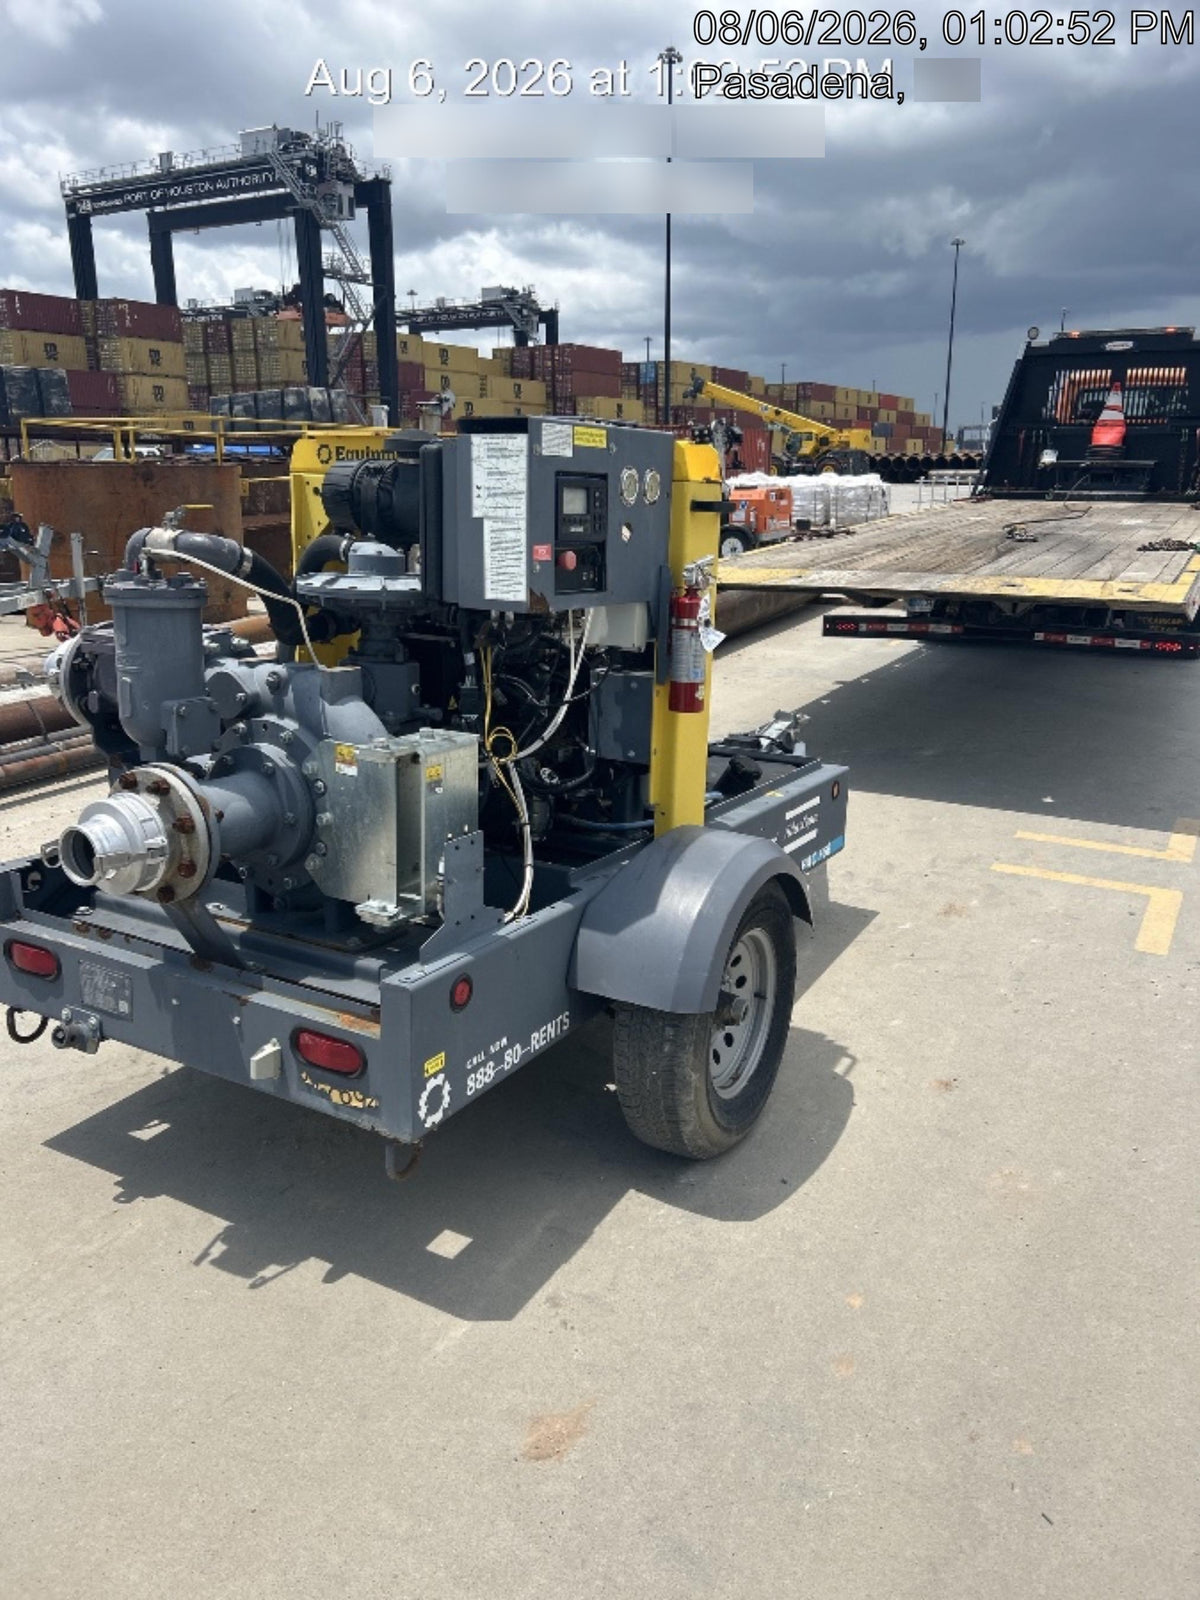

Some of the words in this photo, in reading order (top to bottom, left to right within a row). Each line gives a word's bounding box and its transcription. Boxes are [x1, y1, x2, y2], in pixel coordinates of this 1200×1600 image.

[123, 191, 149, 204] PORT
[150, 188, 166, 201] OF
[166, 180, 214, 199] HOUSTON
[216, 171, 275, 190] AUTHORITY
[466, 1011, 570, 1096] 888-80-RENTS
